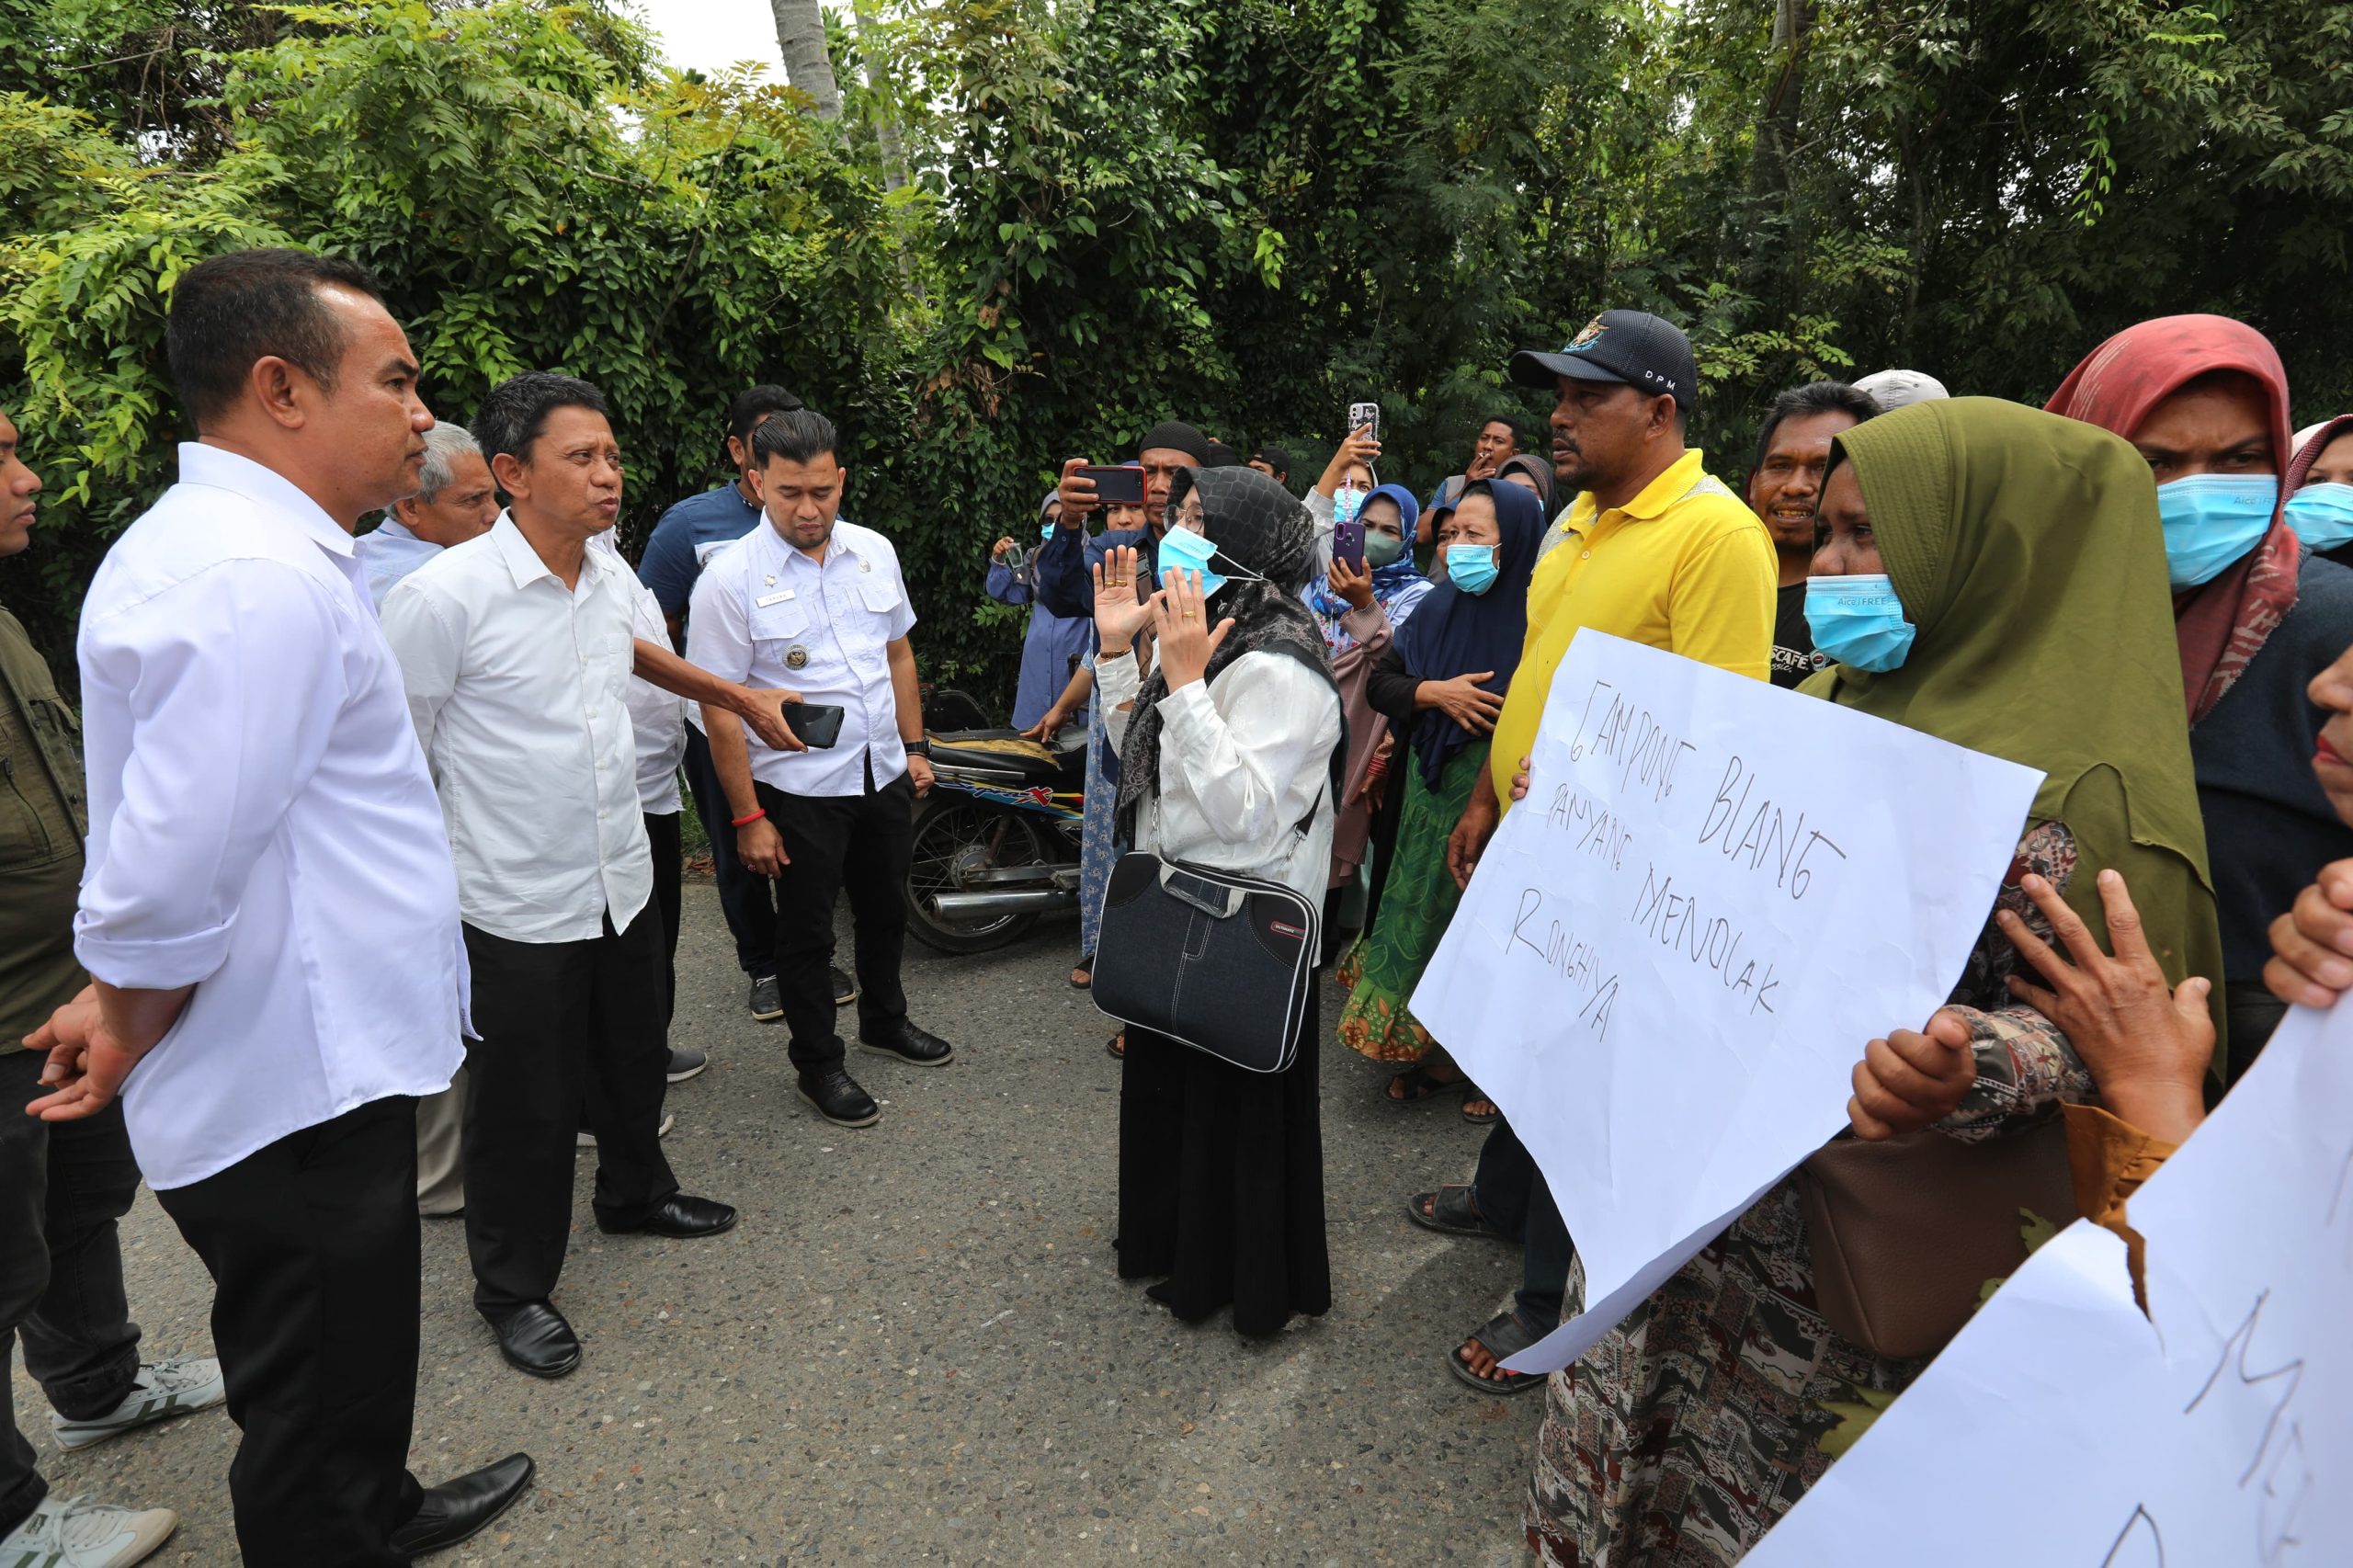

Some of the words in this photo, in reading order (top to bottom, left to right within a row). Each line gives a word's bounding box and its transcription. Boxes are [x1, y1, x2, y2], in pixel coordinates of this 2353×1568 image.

[1645, 369, 1676, 391] DPM
[1771, 646, 1811, 669] SCAFÉ
[1546, 782, 1633, 872] PANYANG
[1631, 861, 1779, 1016] MENOLAK
